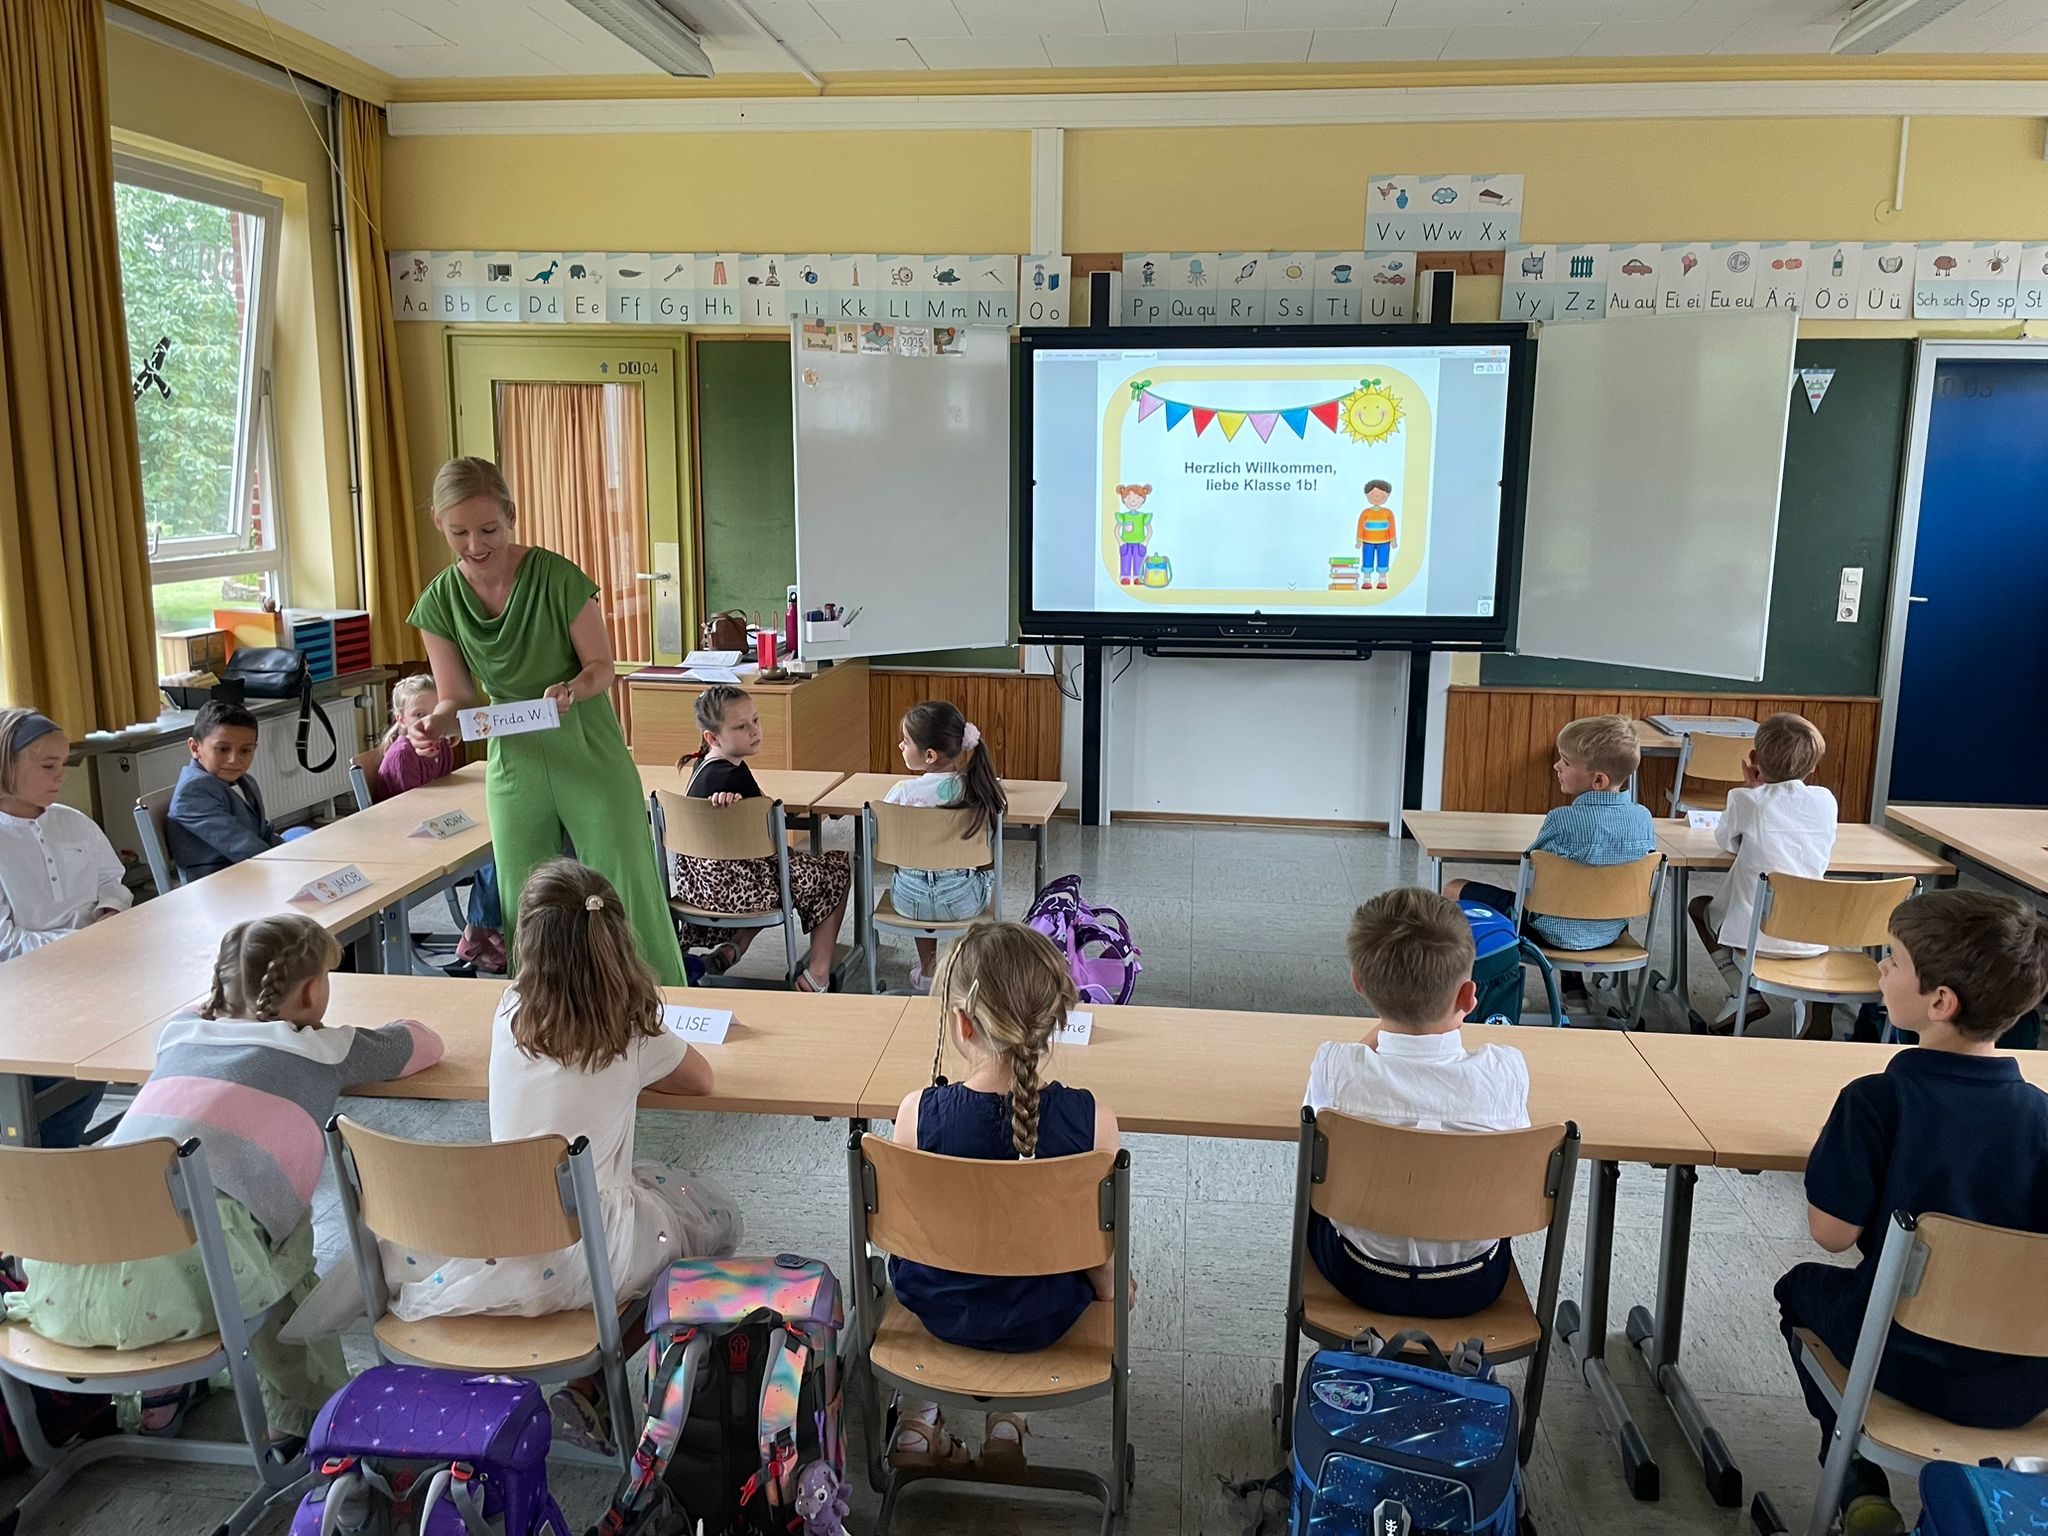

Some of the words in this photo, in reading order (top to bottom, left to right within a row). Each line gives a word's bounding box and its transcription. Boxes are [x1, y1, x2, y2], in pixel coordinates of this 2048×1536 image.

[1184, 461, 1241, 474] Herzlich
[1245, 461, 1337, 476] Willkommen,
[1206, 479, 1239, 491] liebe
[1244, 479, 1291, 491] Klasse
[1296, 479, 1317, 491] 1b!
[492, 713, 524, 727] Frida
[528, 709, 546, 720] W.
[443, 814, 466, 829] ADAM
[333, 871, 362, 893] JAKOB
[675, 1015, 711, 1032] LISE
